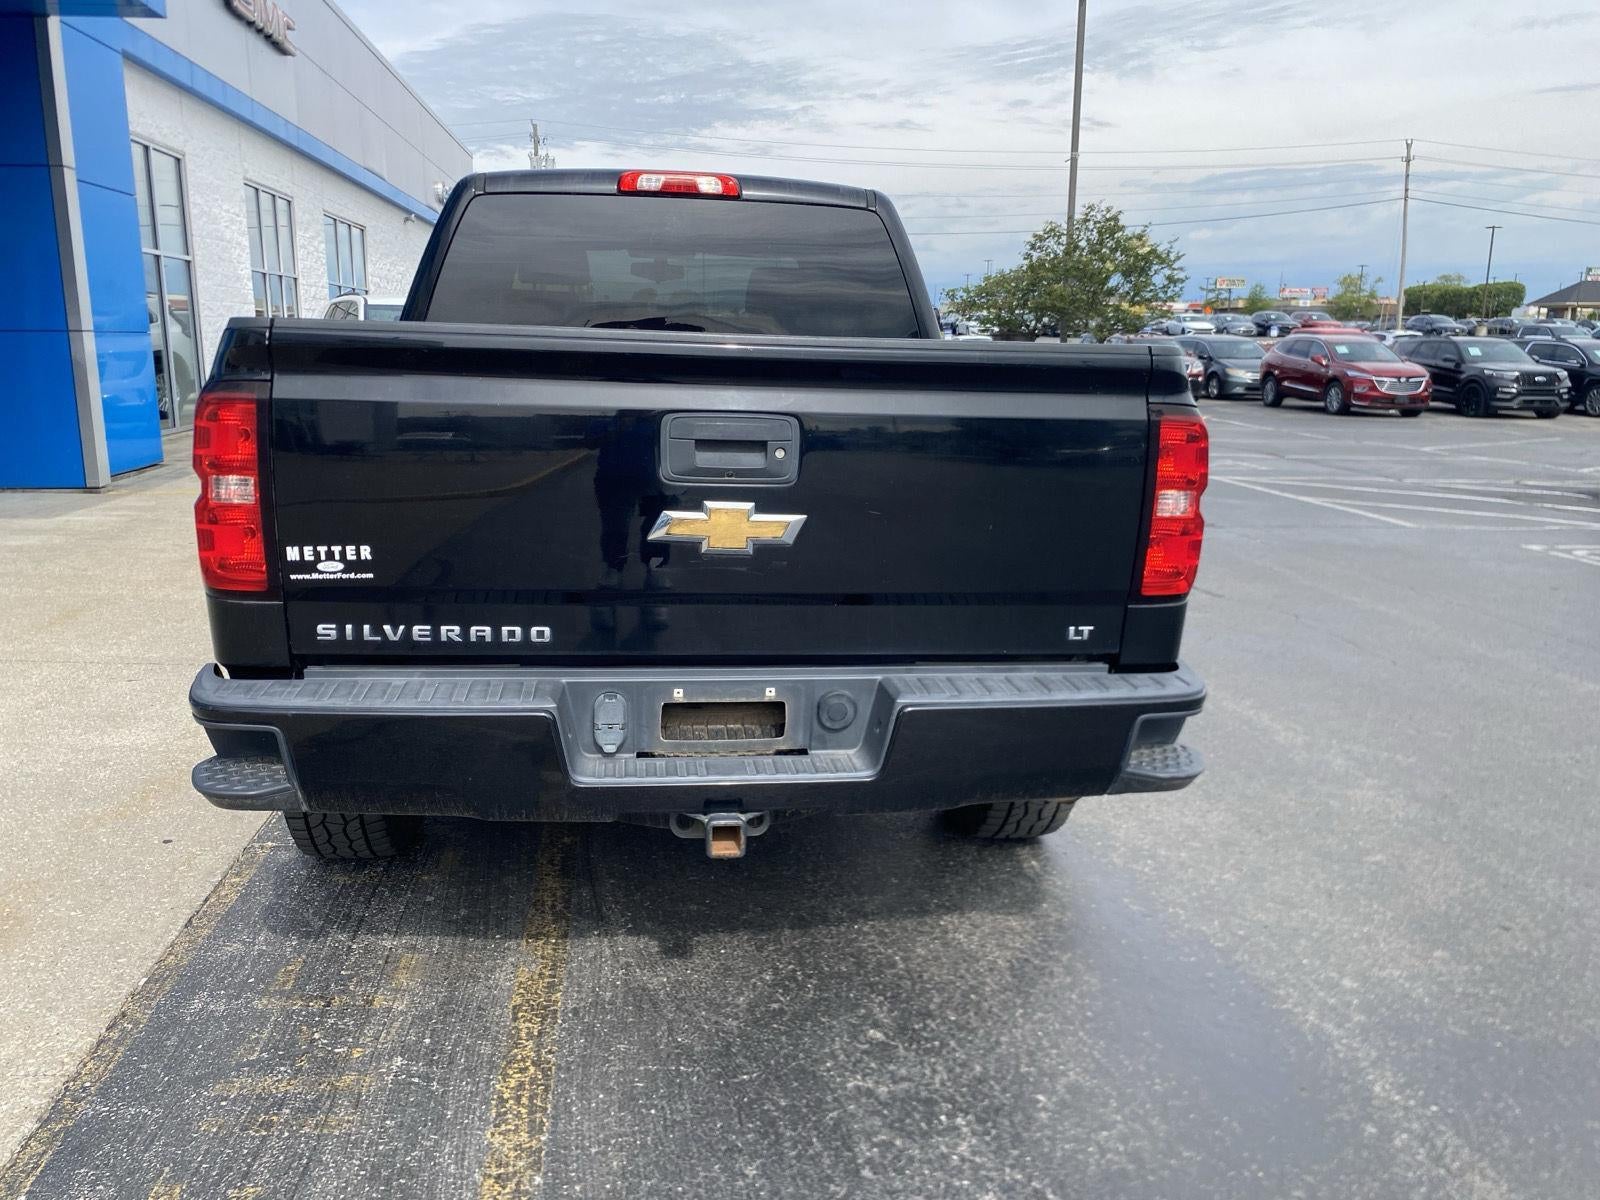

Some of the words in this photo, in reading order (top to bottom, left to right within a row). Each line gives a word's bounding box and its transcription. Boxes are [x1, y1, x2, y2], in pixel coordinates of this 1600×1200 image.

[285, 545, 372, 561] METTER
[289, 572, 374, 580] www.MetterFord.com
[316, 624, 552, 643] SILVERADO
[1069, 626, 1094, 640] LT
